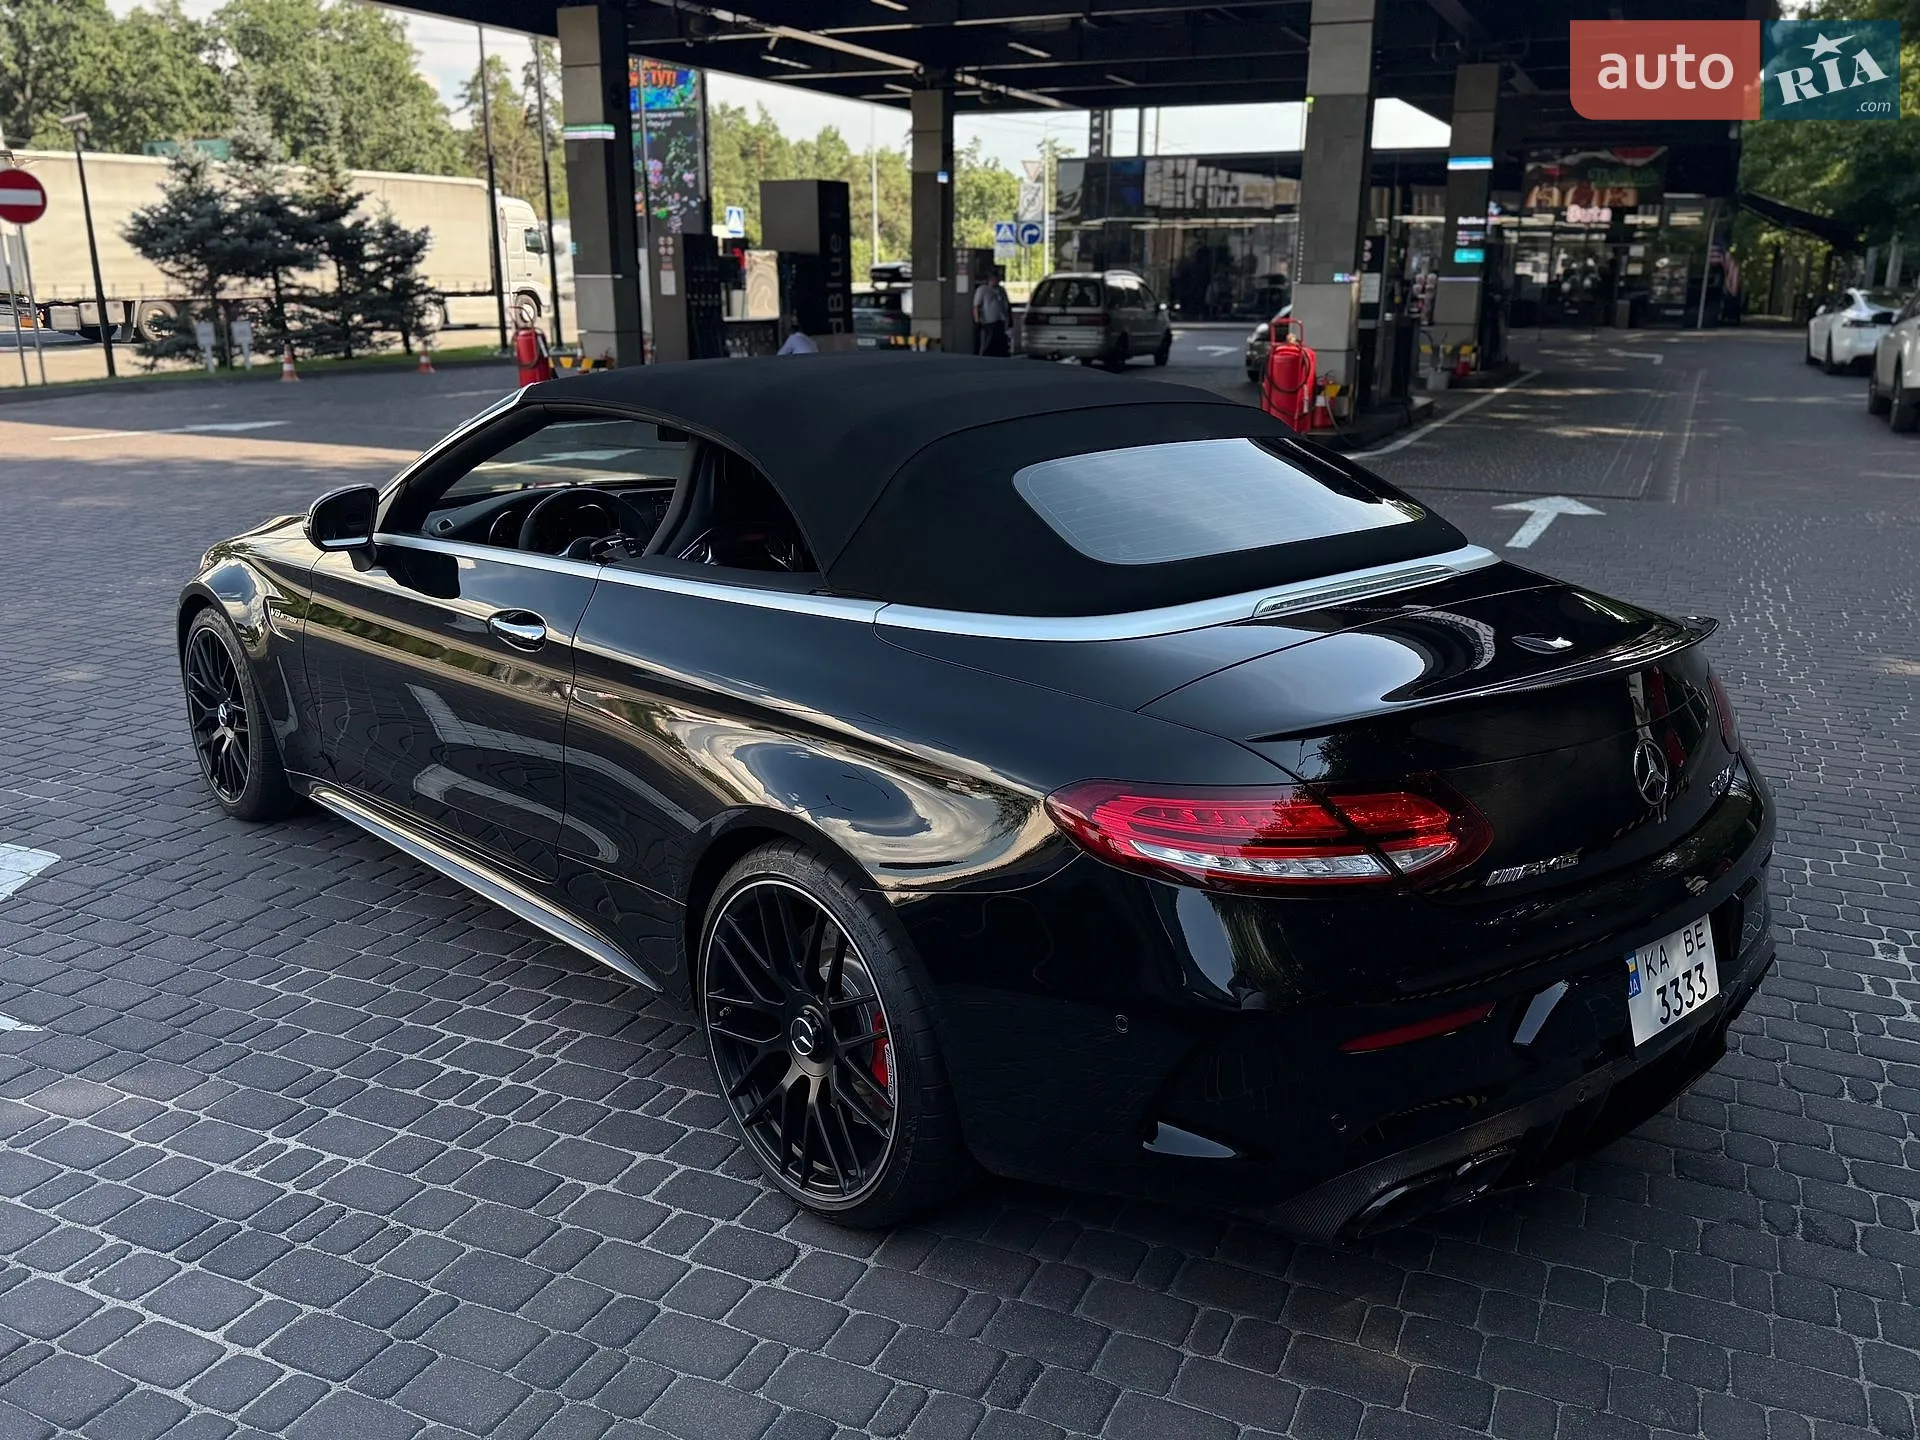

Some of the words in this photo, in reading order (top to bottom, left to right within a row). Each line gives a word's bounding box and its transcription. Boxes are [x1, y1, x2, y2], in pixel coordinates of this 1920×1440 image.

[270, 607, 281, 617] V8
[1644, 944, 1670, 981] KA
[1683, 921, 1706, 958] BE
[1656, 962, 1708, 1025] 3333
